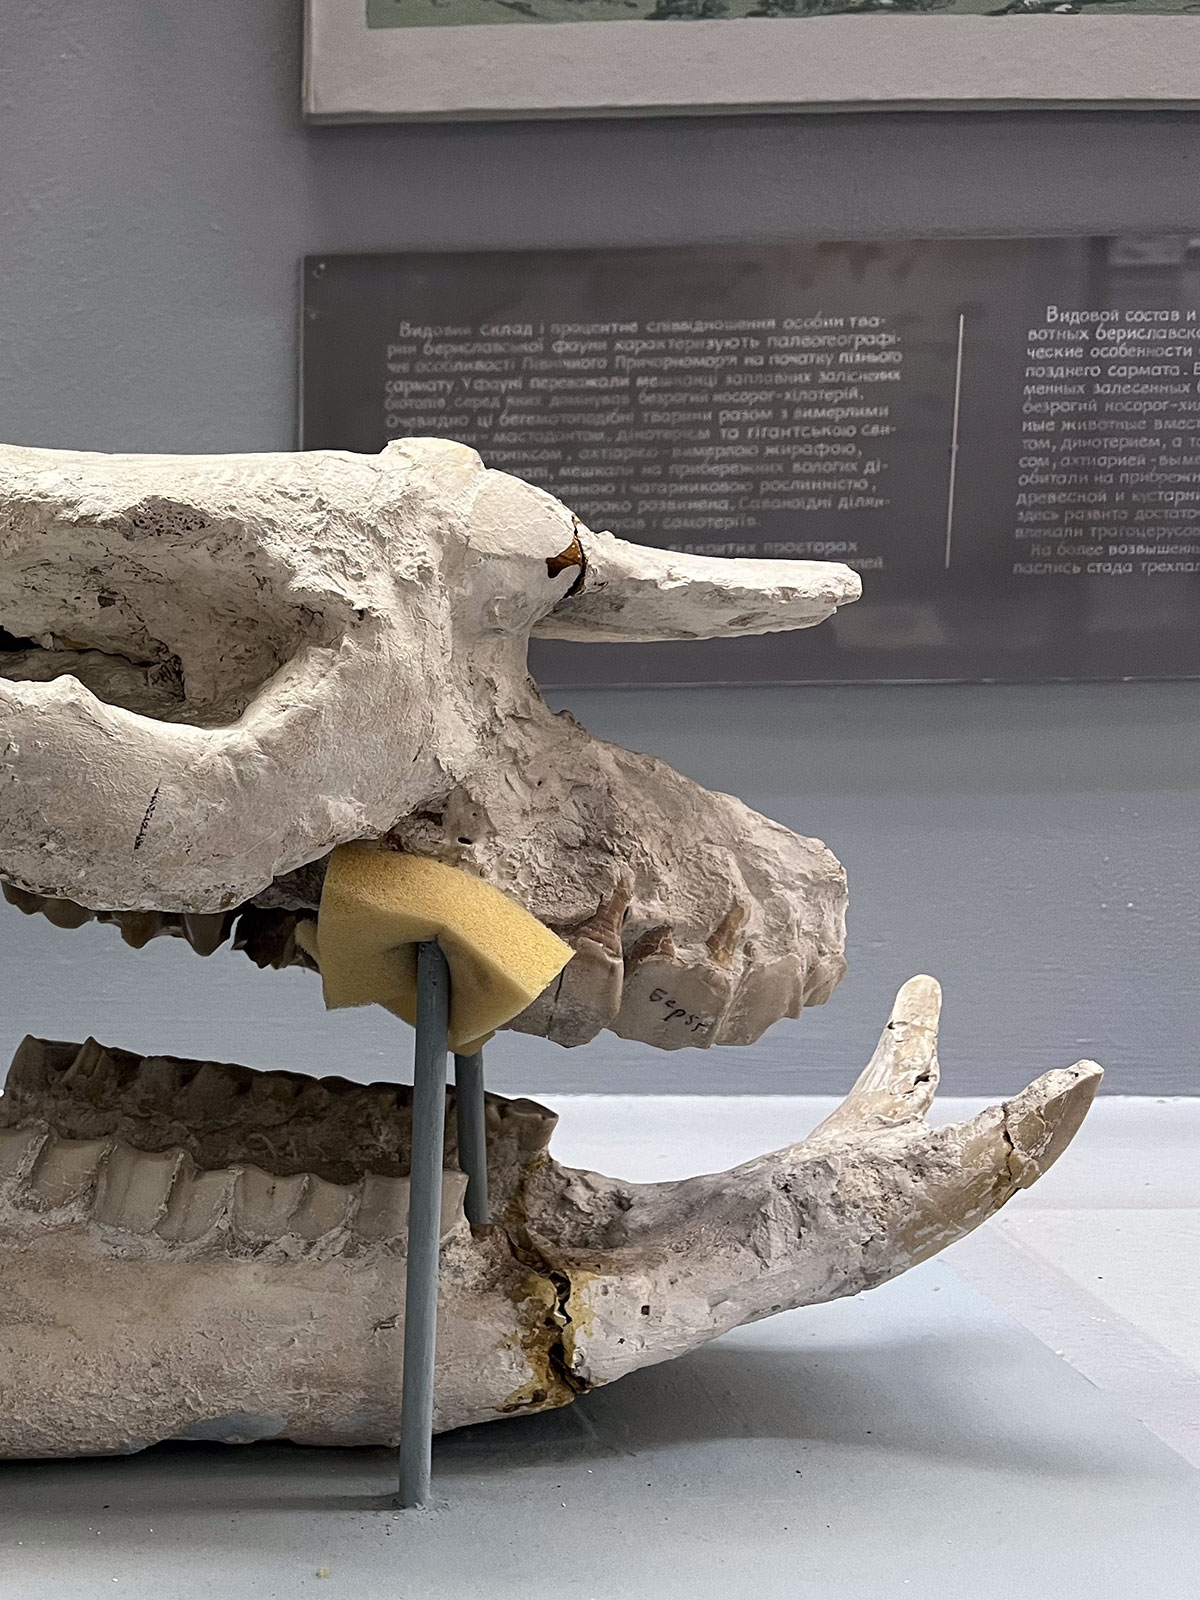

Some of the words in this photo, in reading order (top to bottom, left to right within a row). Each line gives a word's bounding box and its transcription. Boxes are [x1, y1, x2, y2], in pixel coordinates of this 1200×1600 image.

[1046, 305, 1119, 326] Видовой
[1125, 309, 1180, 322] состав
[1186, 310, 1197, 321] и
[1028, 328, 1089, 342] вотных
[1027, 346, 1083, 359] ческие
[1090, 342, 1193, 359] особенности
[1025, 364, 1101, 380] позднего
[1023, 383, 1086, 396] менных
[1093, 381, 1191, 396] залесенных
[1022, 396, 1097, 416] безрогий
[1021, 419, 1056, 432] ные
[1061, 418, 1147, 432] животные
[1171, 436, 1183, 448] а
[1060, 454, 1146, 469] ахтиарией
[1017, 468, 1089, 486] обитали
[1094, 473, 1114, 485] на
[1015, 490, 1107, 507] древесной
[1017, 510, 1060, 523] здесь
[1064, 508, 1129, 525] развито
[1012, 562, 1081, 575] паслись
[1086, 562, 1133, 576] стада
